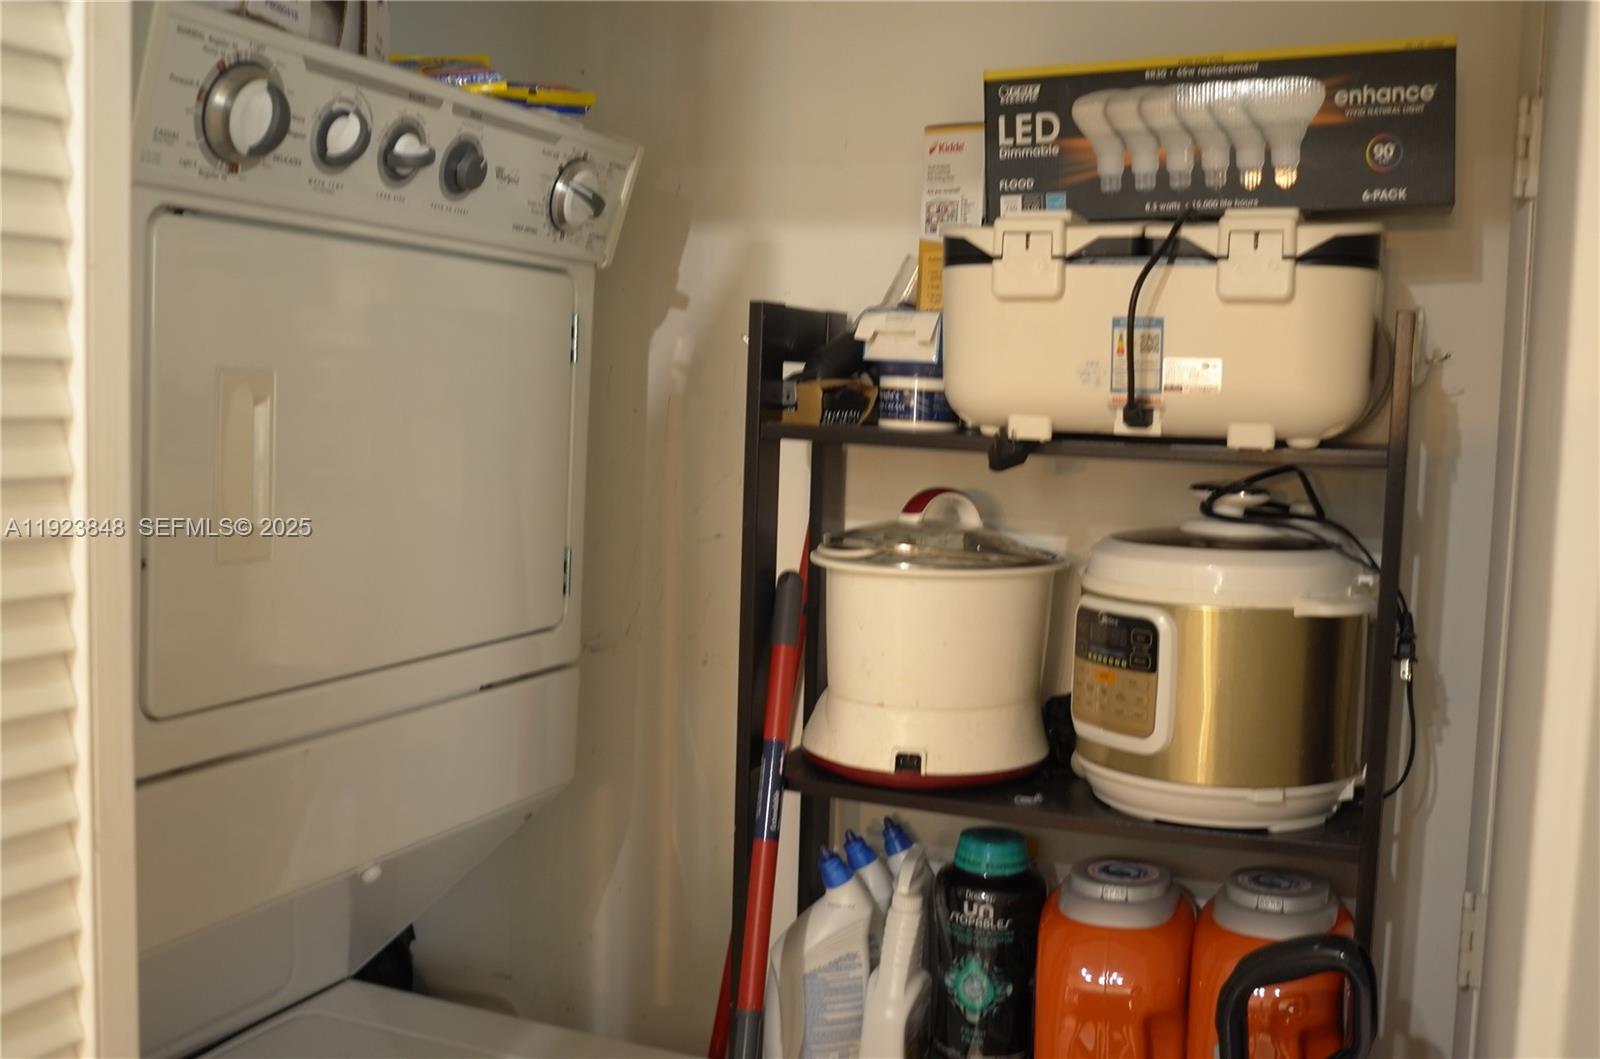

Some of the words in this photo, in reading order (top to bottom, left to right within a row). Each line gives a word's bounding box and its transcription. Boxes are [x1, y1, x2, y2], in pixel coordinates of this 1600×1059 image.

[1198, 62, 1260, 78] replacement
[1334, 84, 1437, 107] enhance
[1366, 105, 1401, 117] NATURAL
[1402, 103, 1426, 115] LIGHT
[998, 111, 1061, 147] LED
[938, 141, 965, 154] Kidde
[998, 145, 1060, 161] Dimmable
[998, 177, 1035, 193] FLOOD
[1361, 187, 1408, 203] 6-PACK
